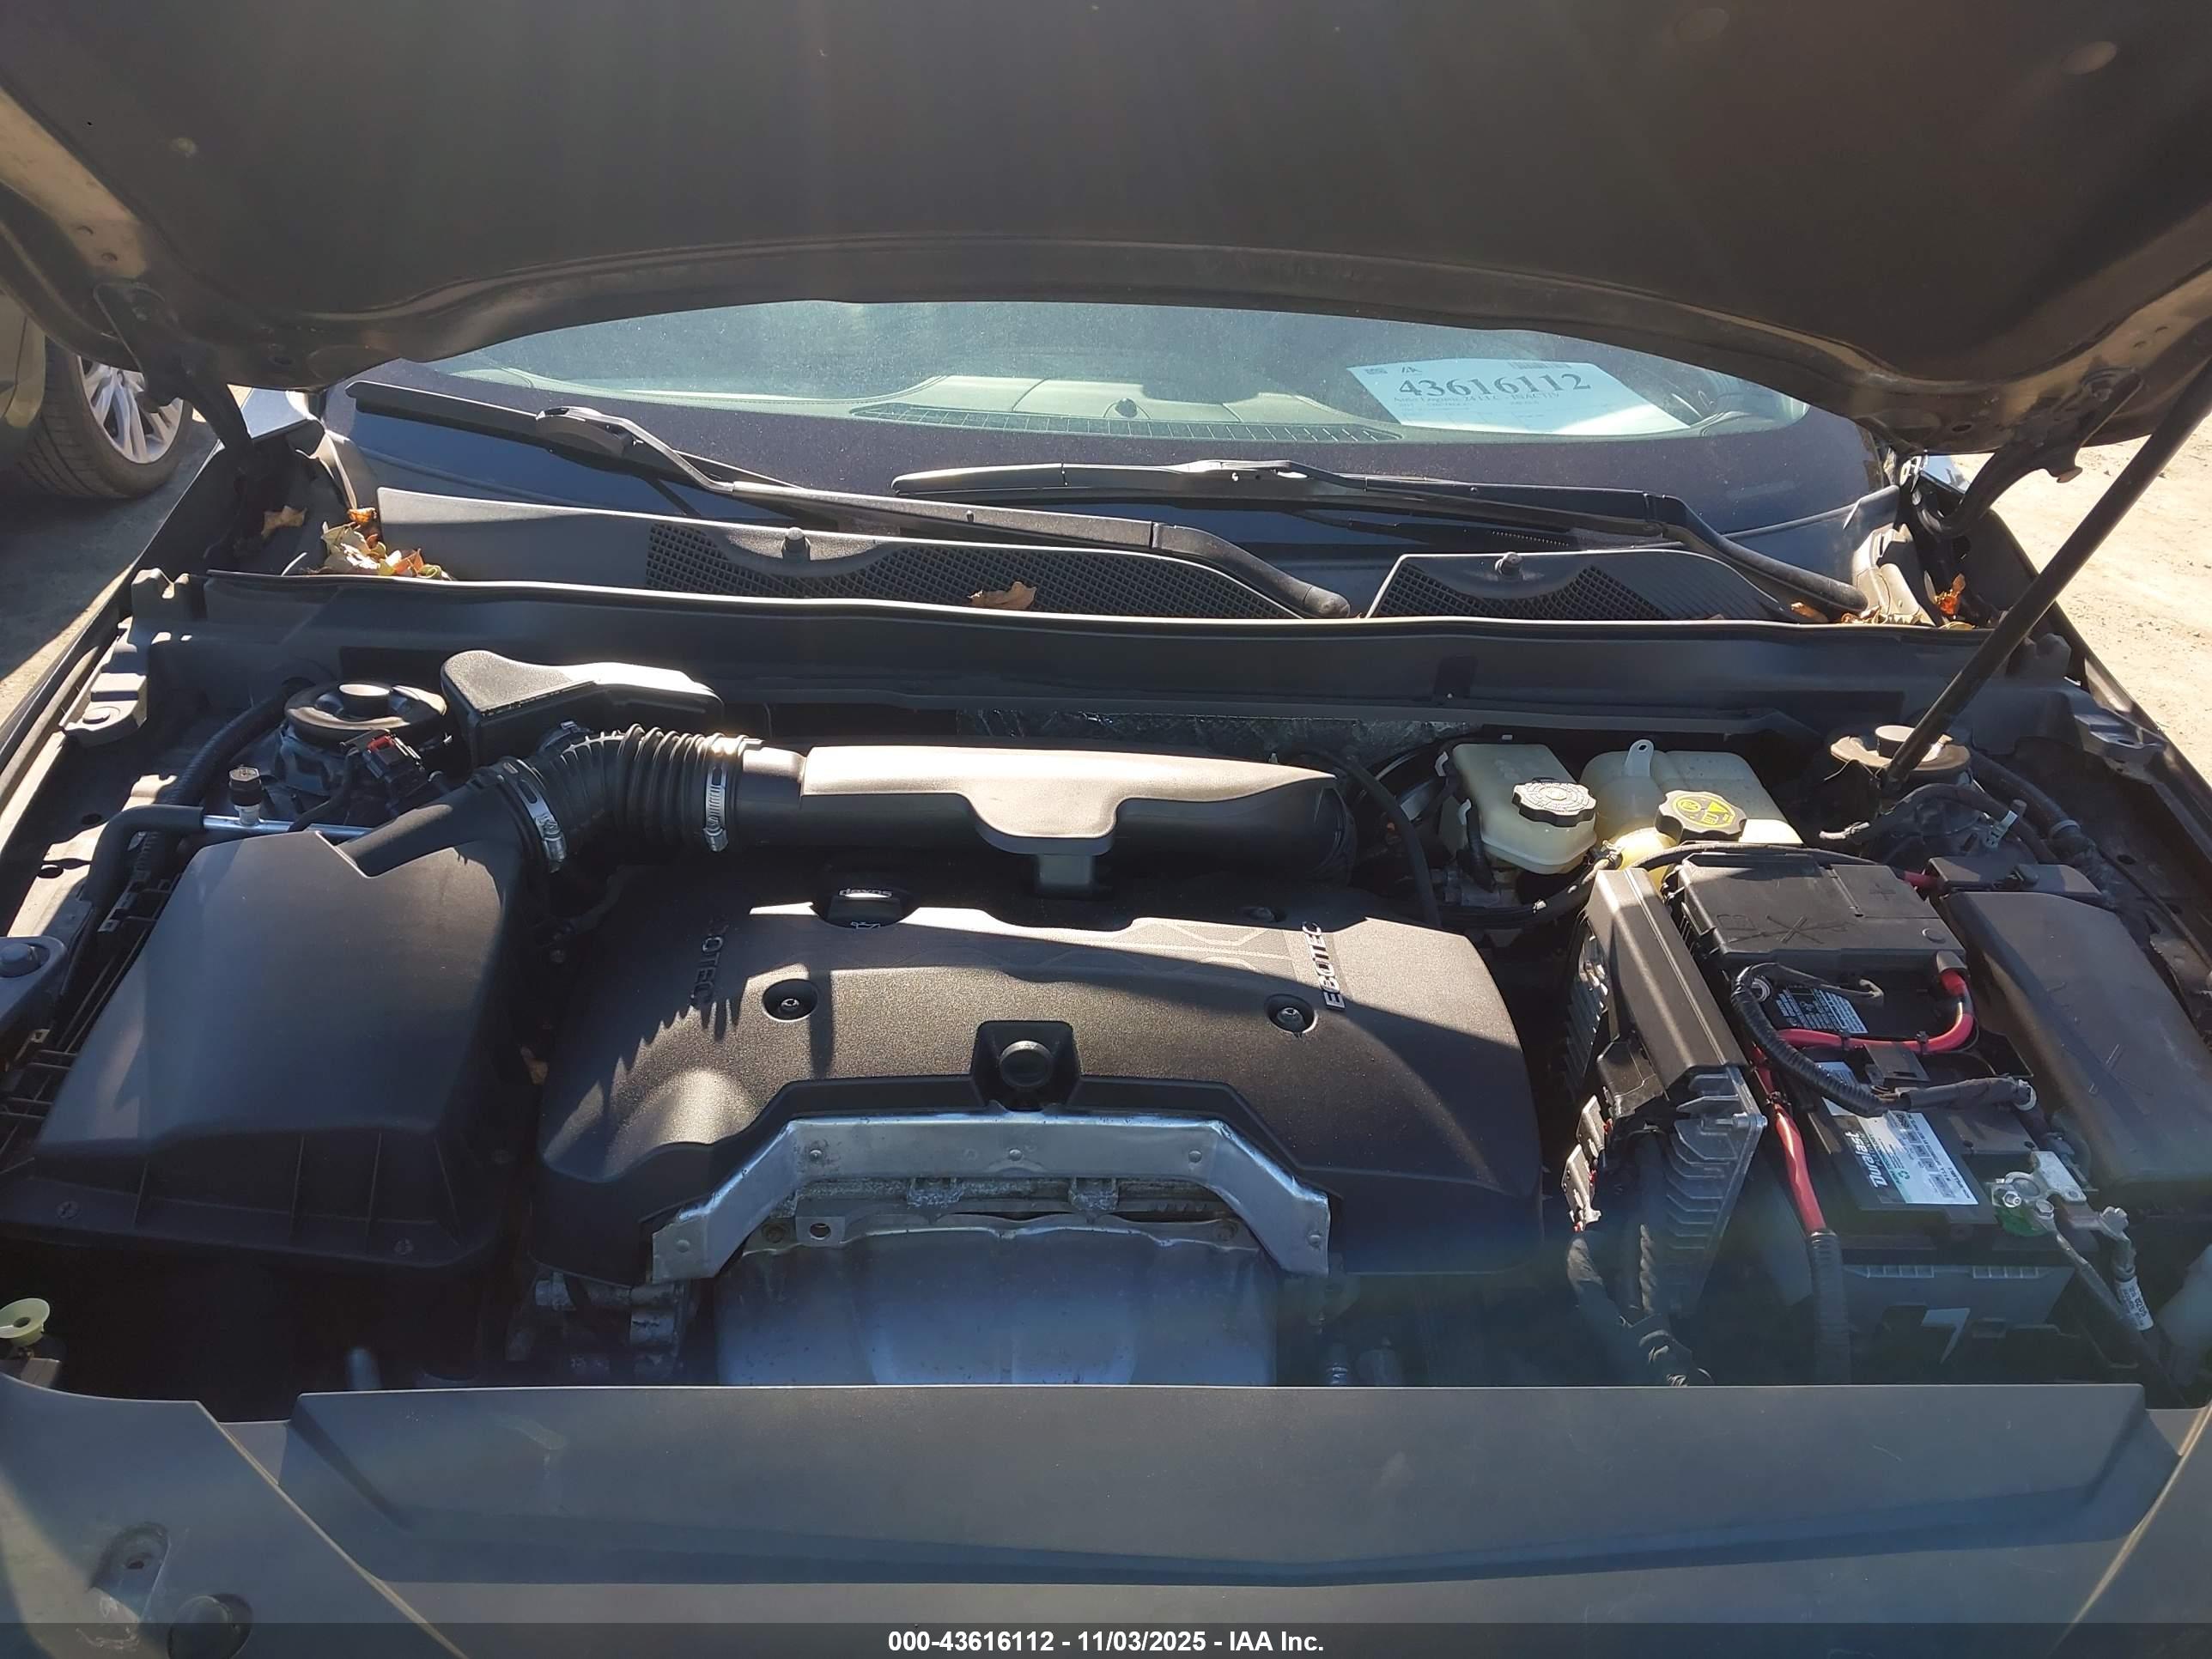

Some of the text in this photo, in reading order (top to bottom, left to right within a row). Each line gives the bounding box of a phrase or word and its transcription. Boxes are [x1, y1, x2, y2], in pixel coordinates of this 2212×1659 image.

[1399, 373, 1591, 397] 43616112
[1301, 921, 1346, 1010] ECOTEC
[1844, 1131, 1888, 1188] Duralast
